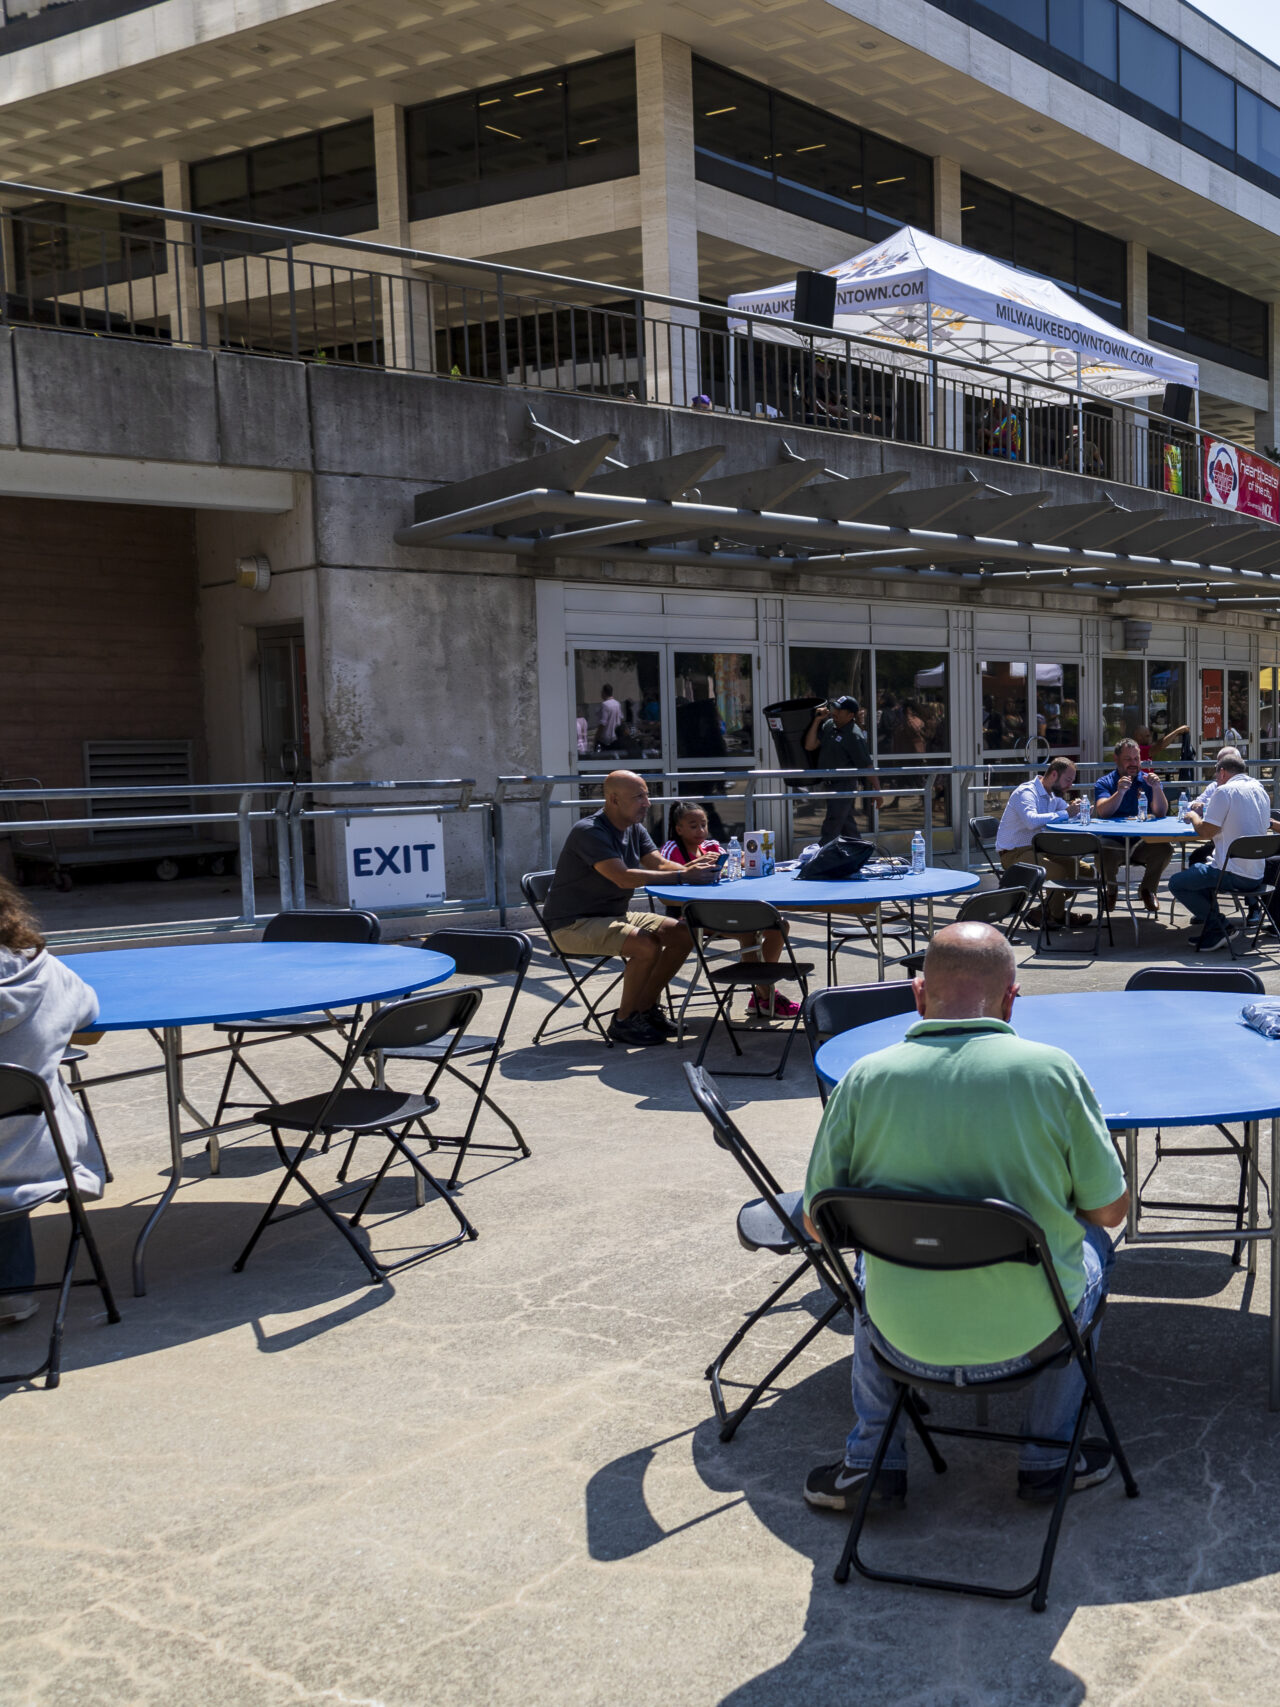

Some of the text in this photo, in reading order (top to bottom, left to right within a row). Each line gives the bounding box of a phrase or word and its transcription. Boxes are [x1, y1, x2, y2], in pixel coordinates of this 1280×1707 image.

[996, 303, 1154, 369] MILWAUKEEDOWNTOWN.COM
[1204, 704, 1221, 715] Coming
[1204, 716, 1216, 724] Soon
[353, 843, 436, 877] EXIT
